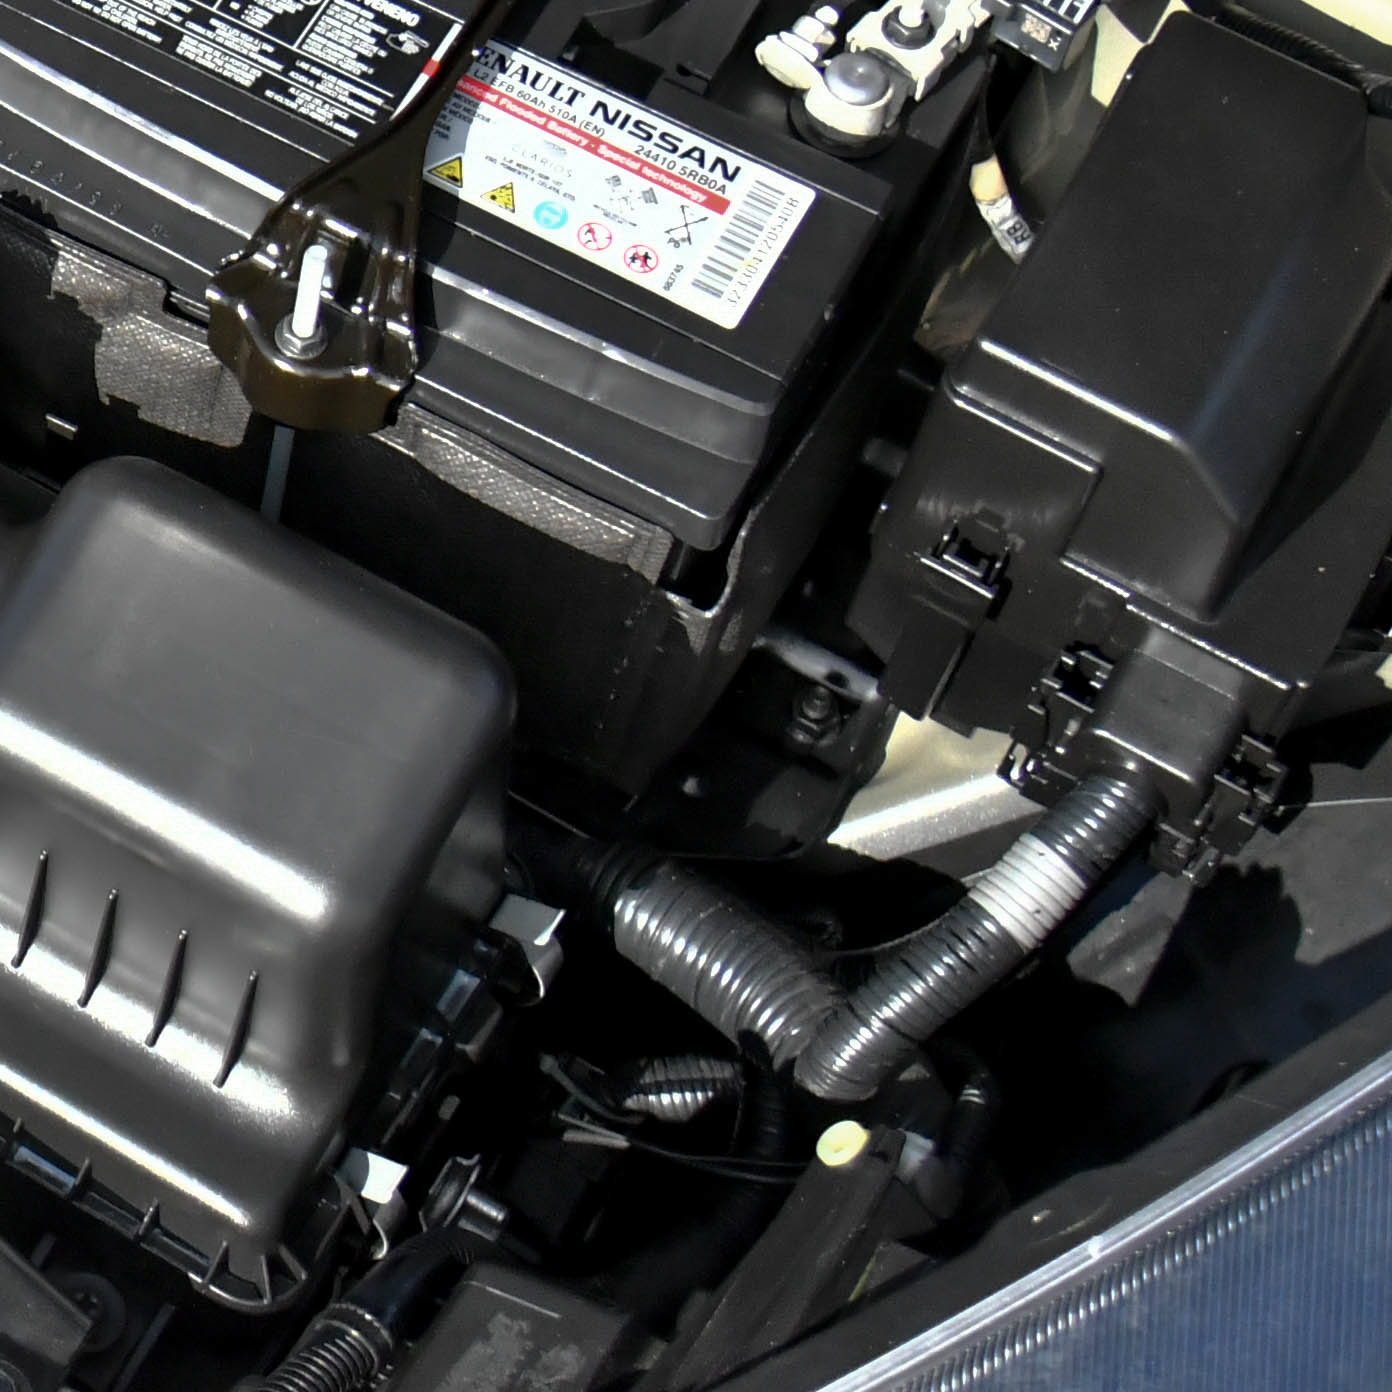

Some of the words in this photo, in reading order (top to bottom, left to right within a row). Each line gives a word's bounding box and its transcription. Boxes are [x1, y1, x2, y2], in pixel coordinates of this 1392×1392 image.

[475, 45, 586, 109] ENAULT
[588, 99, 741, 182] NISSAN
[490, 76, 514, 93] EFB
[516, 89, 546, 109] 60Ah
[547, 104, 577, 123] 510A
[578, 118, 606, 137] (EN)
[497, 96, 547, 126] Flooded
[545, 119, 589, 147] Battery
[595, 143, 642, 172] Special
[639, 164, 709, 204] technology
[633, 144, 677, 171] 24410
